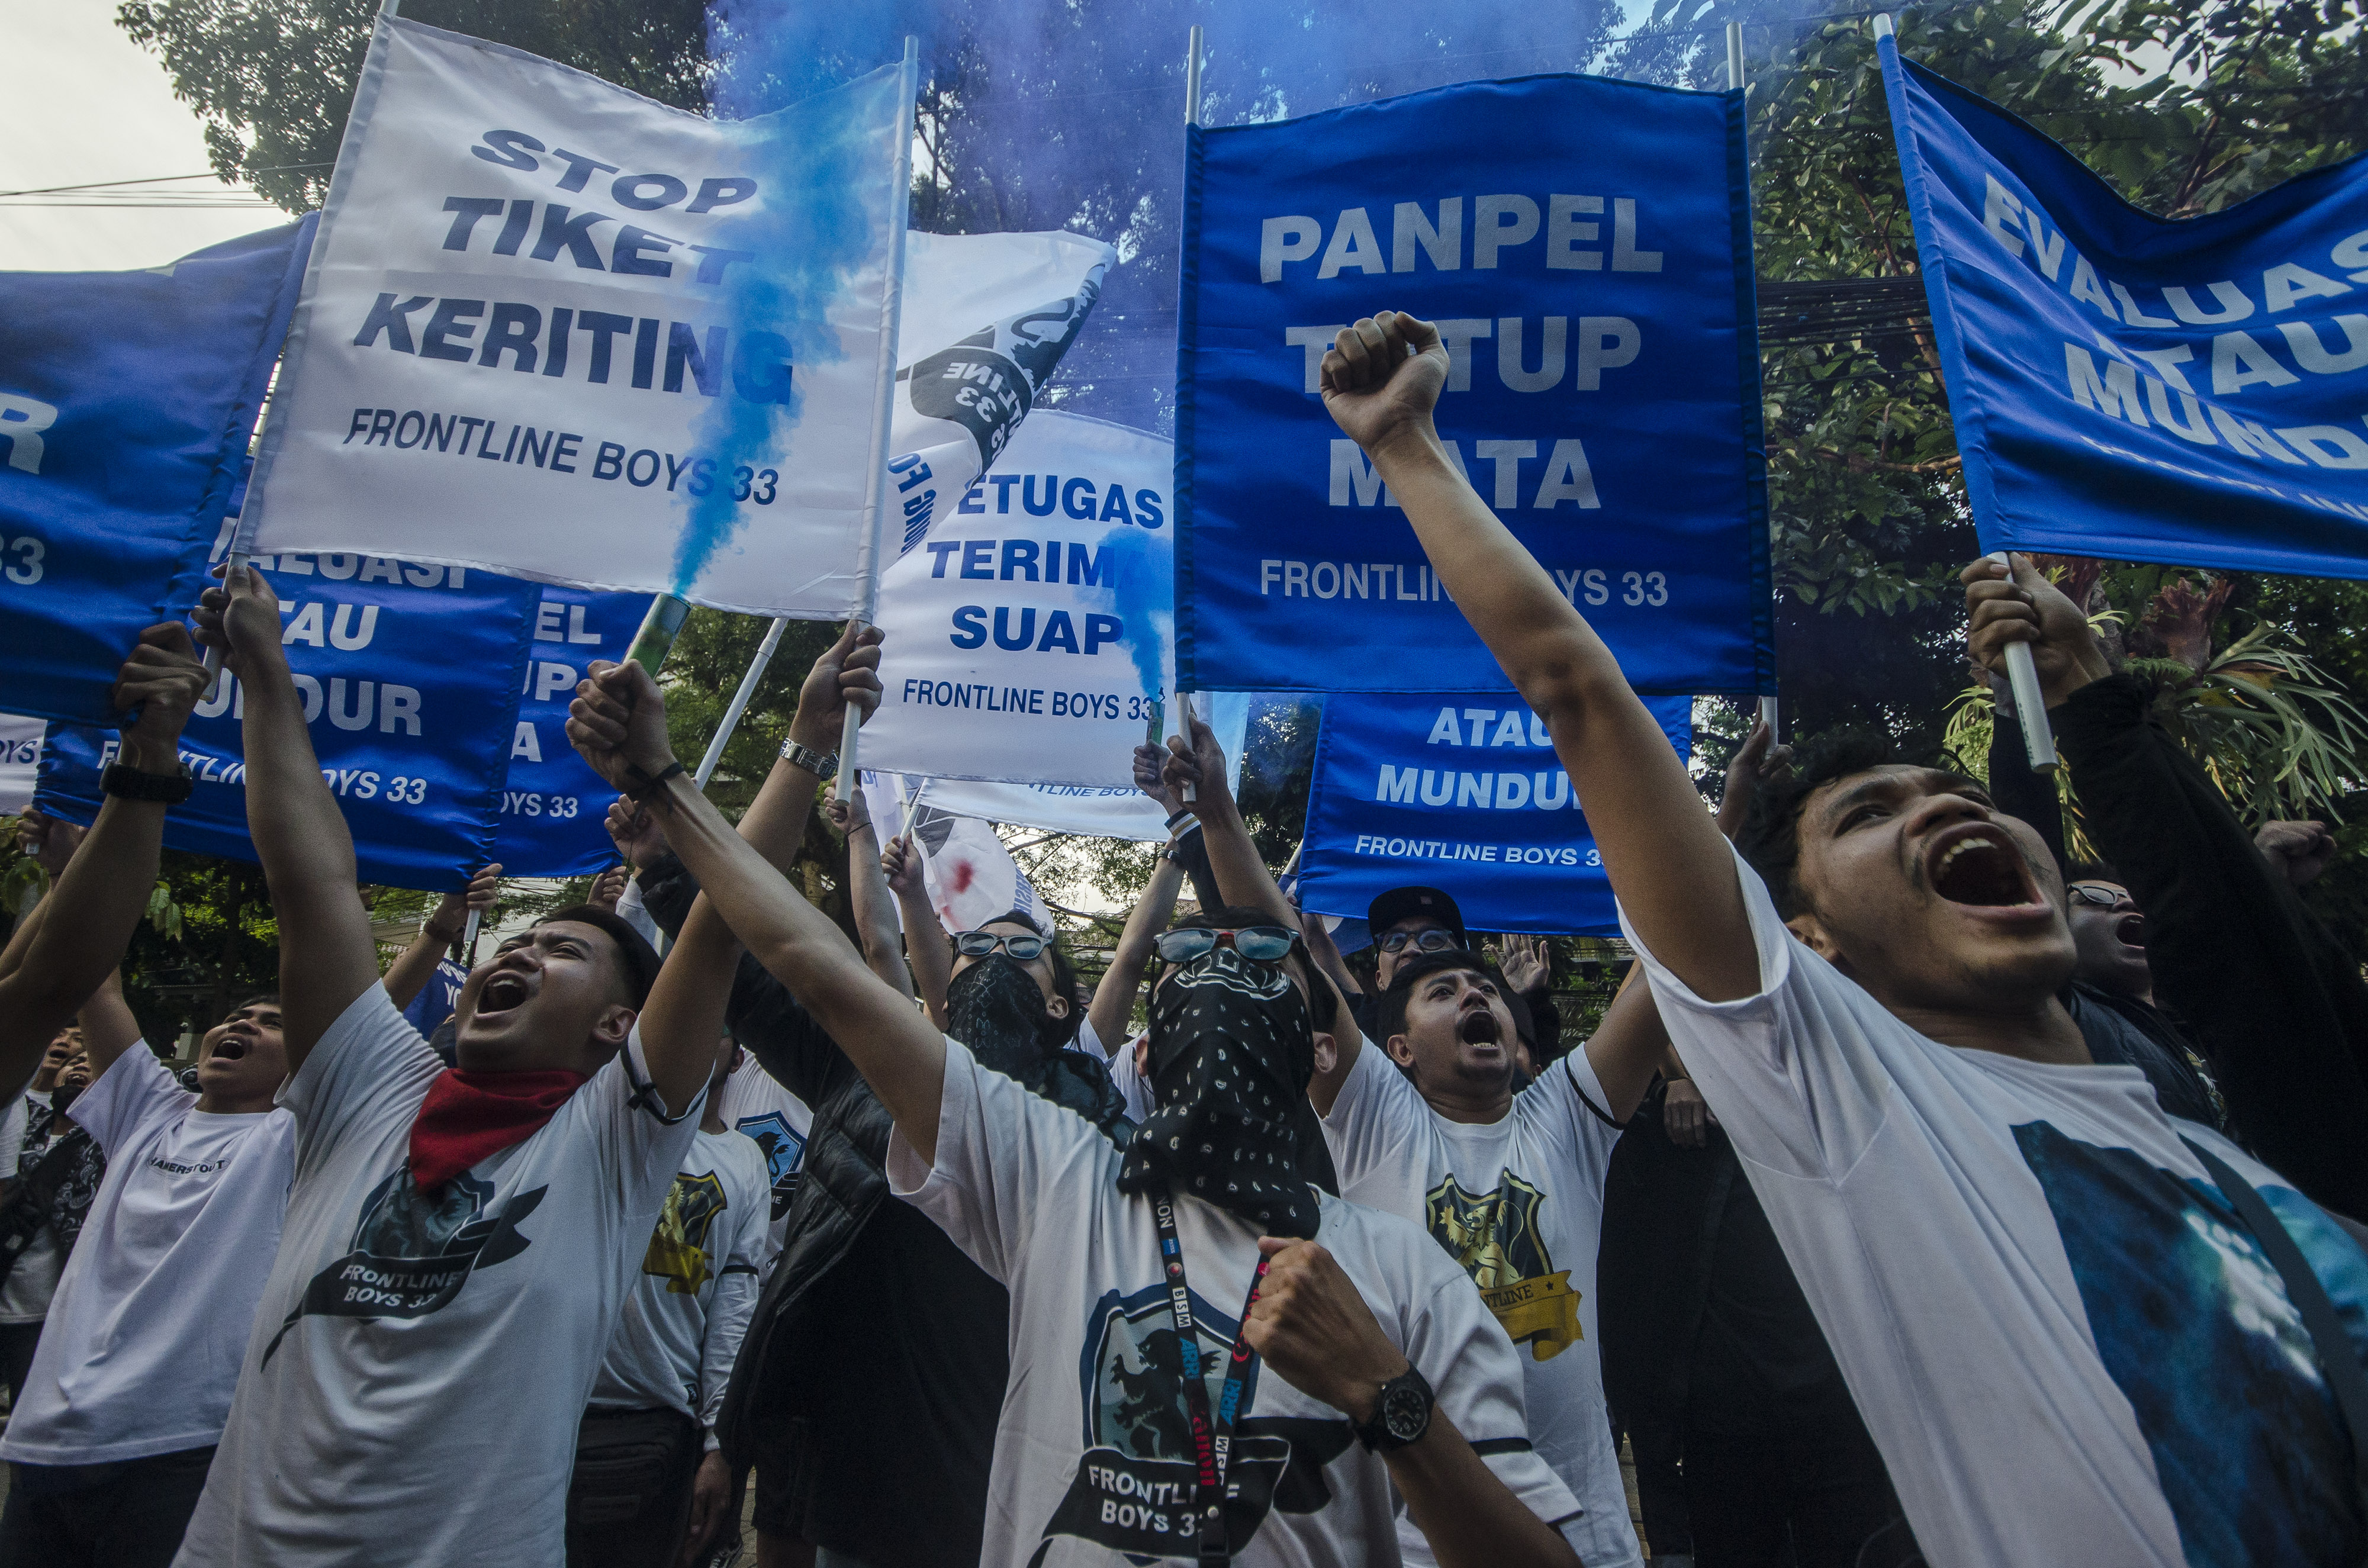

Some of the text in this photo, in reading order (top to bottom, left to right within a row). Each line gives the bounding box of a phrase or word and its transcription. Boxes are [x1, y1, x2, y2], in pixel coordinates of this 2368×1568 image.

[471, 129, 758, 214] STOP
[442, 196, 755, 286] TIKET
[1260, 193, 1664, 284] PANPEL
[353, 291, 793, 405] KERITING
[1285, 315, 1642, 394] TTUP
[2064, 342, 2368, 469] MUND
[343, 408, 780, 506] FRONTLINE BOYS 33
[1329, 438, 1601, 510] MTA
[957, 474, 1164, 529] ETUGAS
[0, 536, 46, 585] 3
[926, 539, 1115, 589] TERIM
[1260, 559, 1669, 607] FRONTLIN YS 33
[278, 600, 380, 651] AU
[950, 605, 1124, 655] SUAP
[903, 678, 1044, 714] FRONTLINE
[1052, 690, 1119, 720] BOYS
[0, 739, 38, 764] YS
[386, 775, 427, 805] 33
[549, 795, 578, 819] 33
[1375, 764, 1584, 811] MUNDU
[1354, 835, 1604, 867] FRONTLINE BOYS 3
[339, 1264, 462, 1289] FRONTLINE
[343, 1286, 404, 1307] BOYS
[1089, 1464, 1240, 1506] FRONTLIE
[1101, 1498, 1203, 1538] BOYS 3
